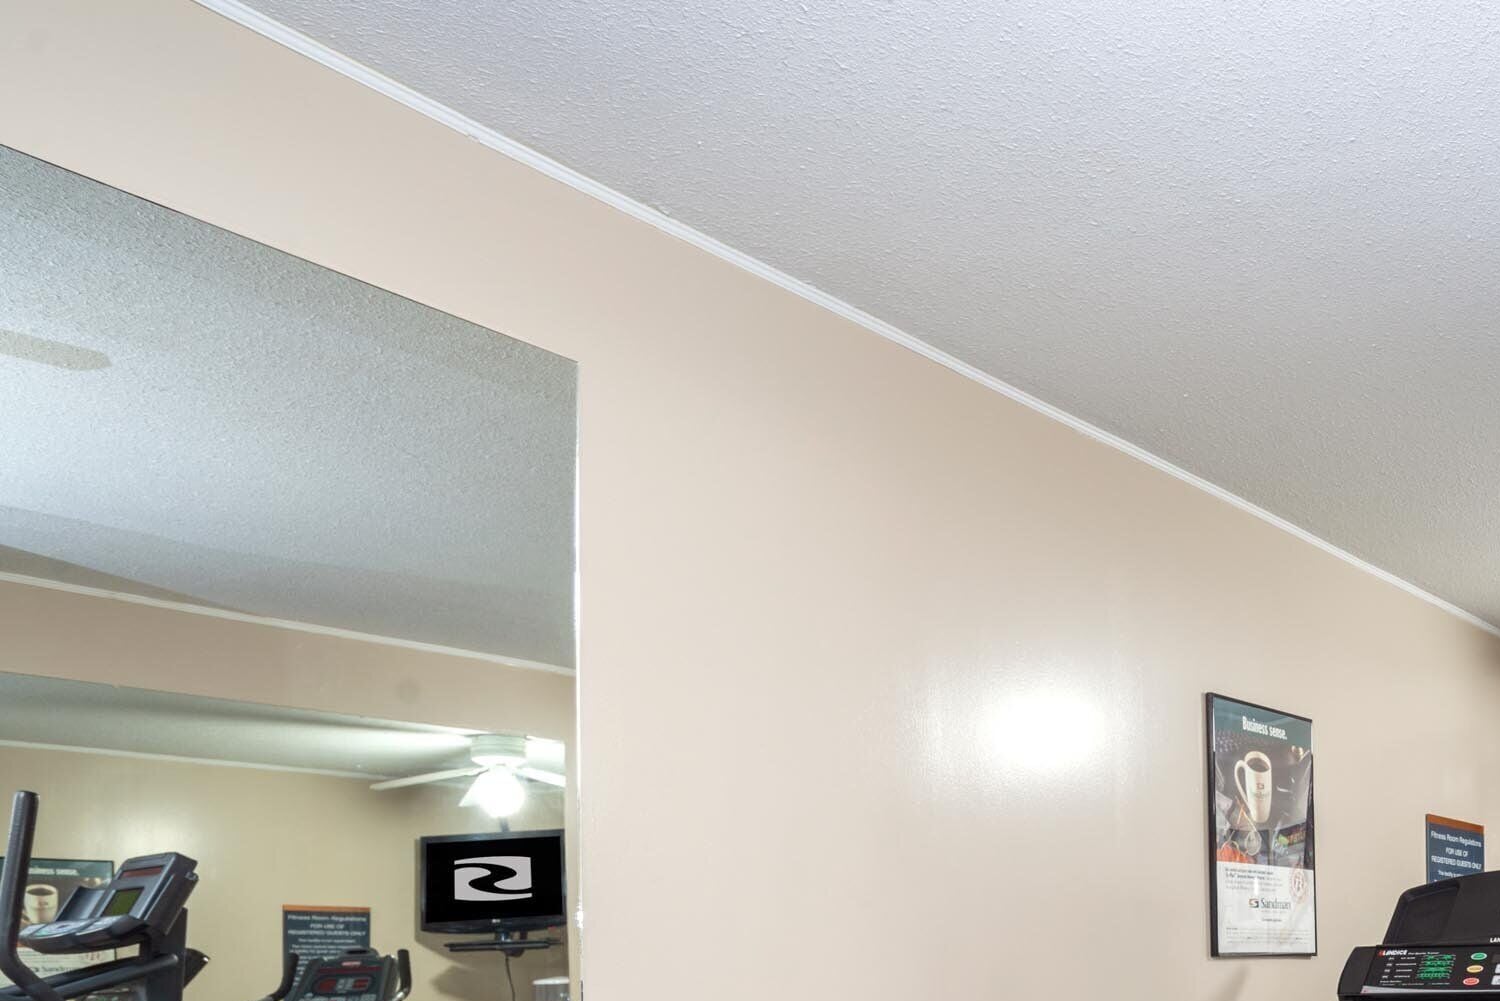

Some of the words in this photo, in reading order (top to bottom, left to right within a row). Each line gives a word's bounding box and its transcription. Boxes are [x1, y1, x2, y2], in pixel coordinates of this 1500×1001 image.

[1242, 715, 1268, 736] Business
[1431, 830, 1446, 840] Fitness
[1447, 834, 1459, 842] Room
[1446, 847, 1454, 855] FOR
[1260, 898, 1291, 910] Sandman
